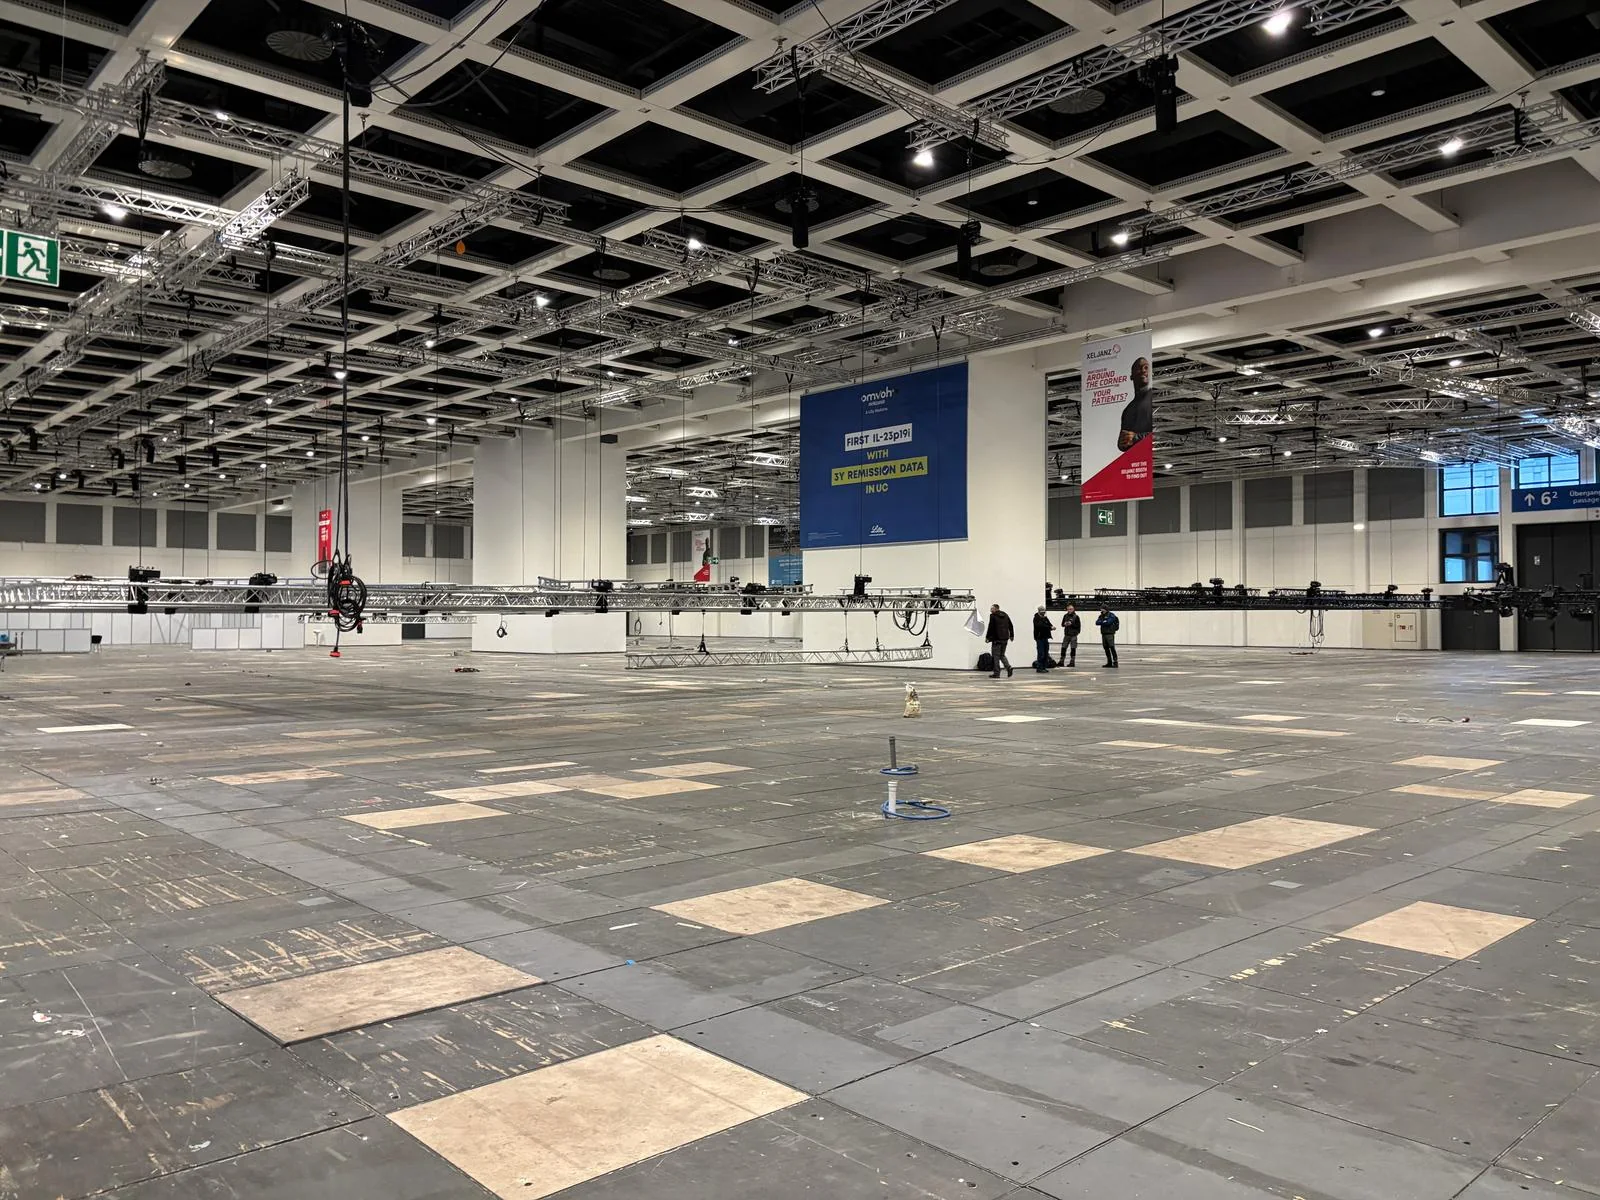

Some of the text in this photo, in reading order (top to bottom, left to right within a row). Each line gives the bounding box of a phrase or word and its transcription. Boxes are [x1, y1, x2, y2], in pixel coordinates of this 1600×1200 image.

[1086, 349, 1112, 359] XELJANZ
[1086, 370, 1115, 381] AROUND
[1086, 380, 1100, 388] THE
[1099, 375, 1128, 386] CORNER
[861, 386, 893, 401] omvoh
[1092, 393, 1128, 404] PATIENTS?
[1093, 389, 1111, 398] YOUR
[846, 429, 911, 447] FIRST IL-23p19i
[866, 449, 889, 460] WITH
[834, 461, 924, 481] 3Y REMISSION DATA
[865, 482, 889, 494] IN UC
